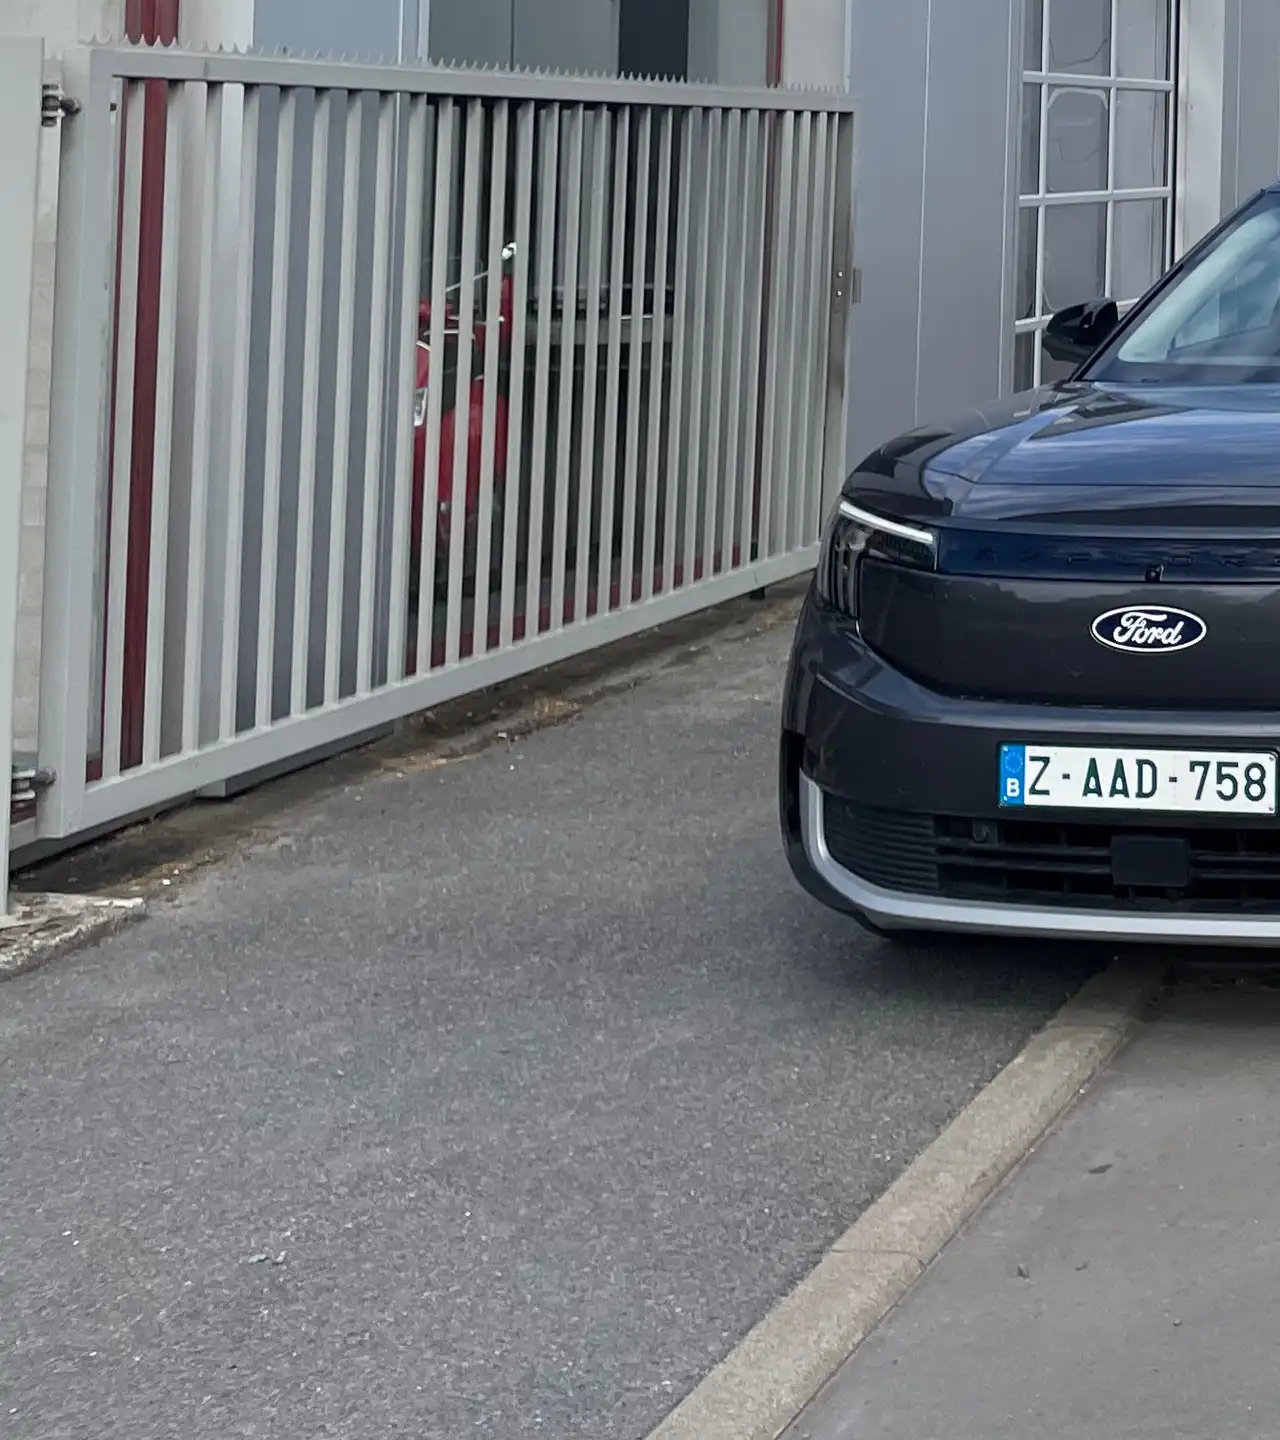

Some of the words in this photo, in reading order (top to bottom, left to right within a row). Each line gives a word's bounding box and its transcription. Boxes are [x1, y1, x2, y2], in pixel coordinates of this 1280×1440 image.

[1113, 611, 1184, 644] Ford
[1006, 777, 1020, 797] B
[1028, 755, 1266, 802] Z-AAD-758
